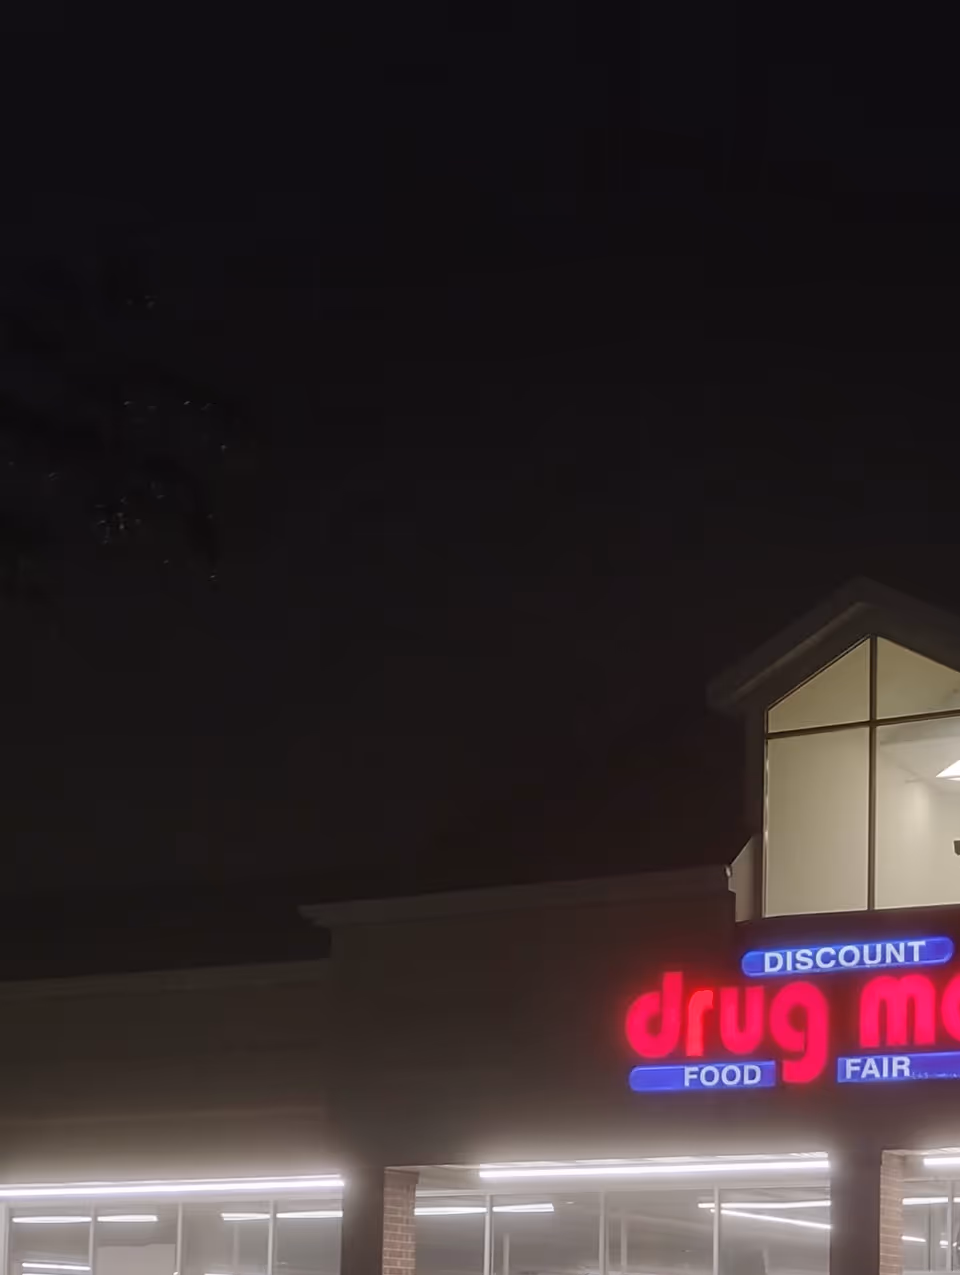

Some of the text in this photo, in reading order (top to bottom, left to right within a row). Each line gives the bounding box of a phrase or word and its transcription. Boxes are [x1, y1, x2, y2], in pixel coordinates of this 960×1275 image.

[763, 941, 927, 973] DISCOUNT
[625, 971, 830, 1083] drug
[683, 1055, 911, 1087] FOOD FAIR
